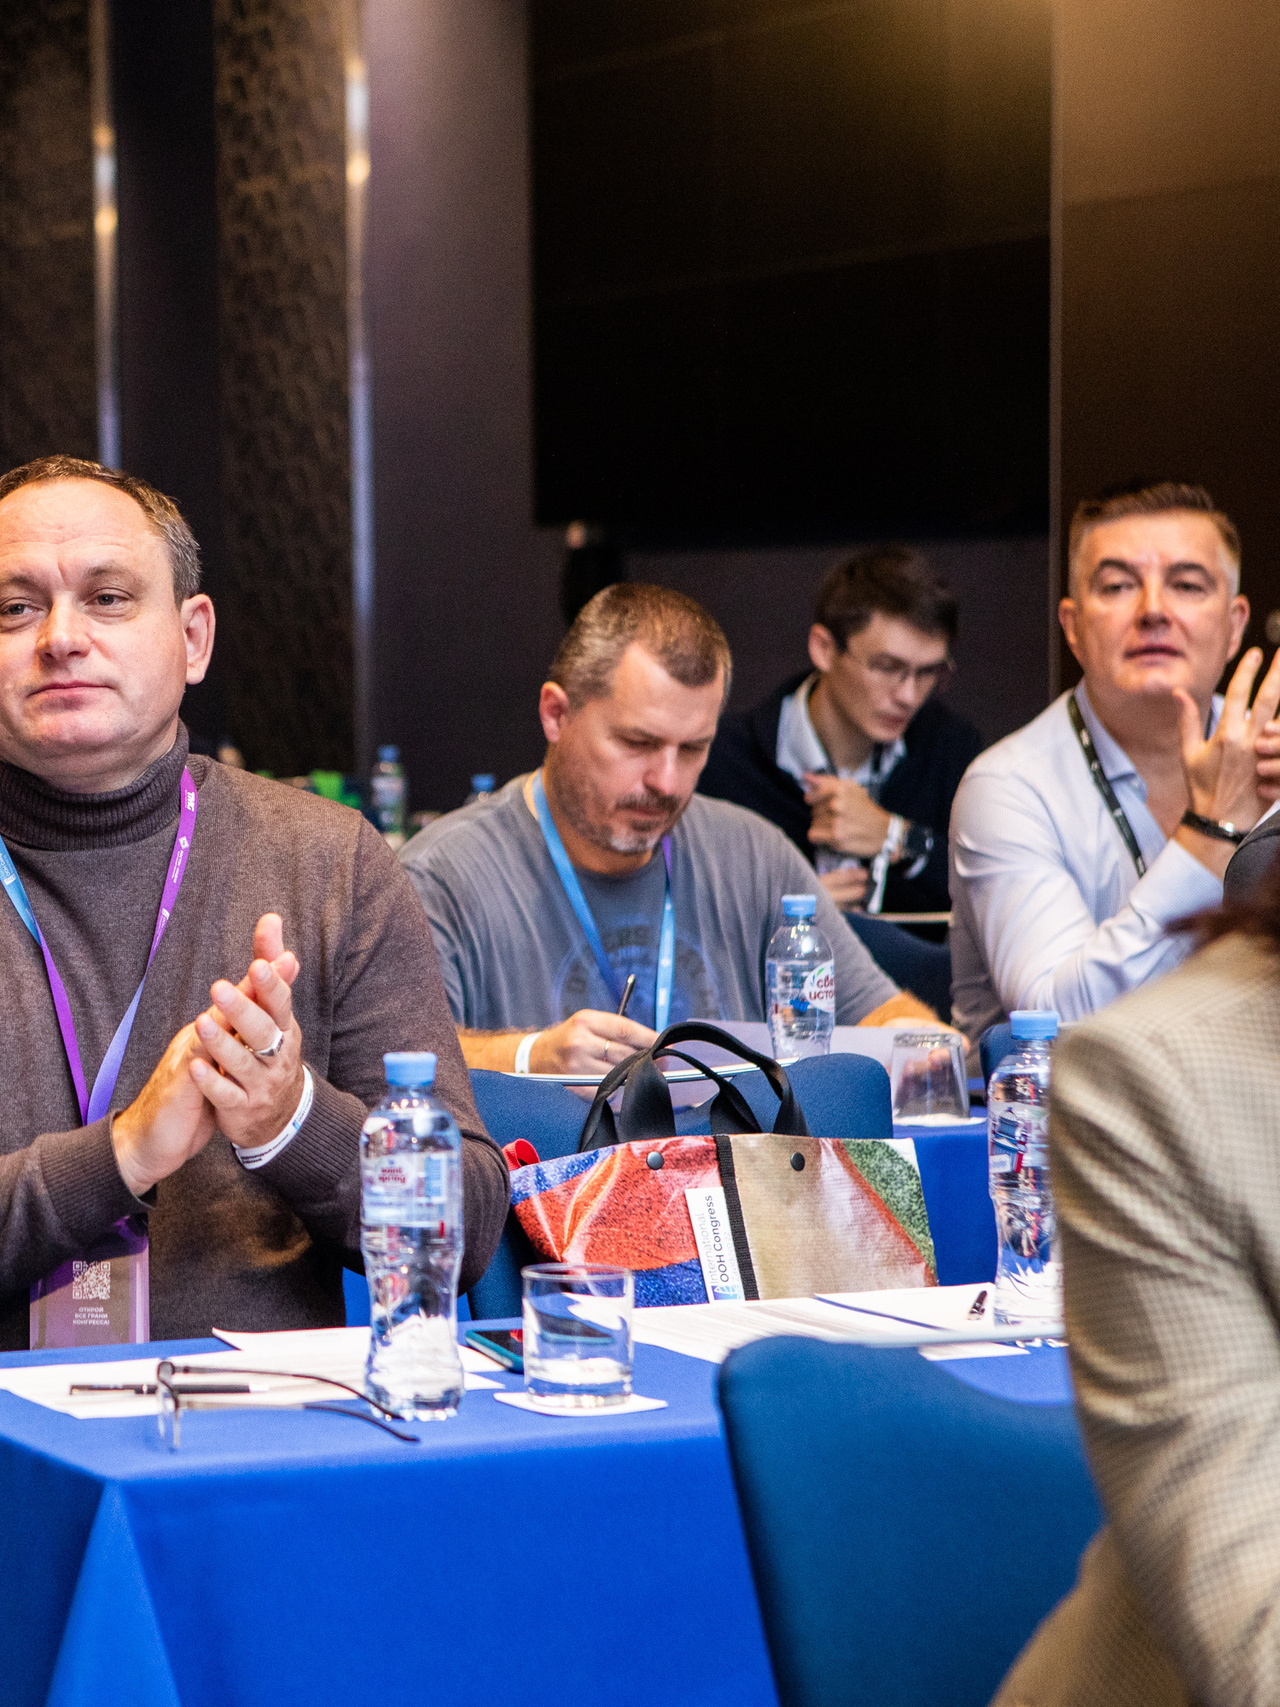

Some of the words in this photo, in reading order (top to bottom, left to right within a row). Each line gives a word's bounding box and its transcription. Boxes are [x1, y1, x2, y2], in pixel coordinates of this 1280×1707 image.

[695, 1213, 718, 1284] International
[705, 1195, 722, 1252] Congress
[716, 1254, 729, 1282] OOH
